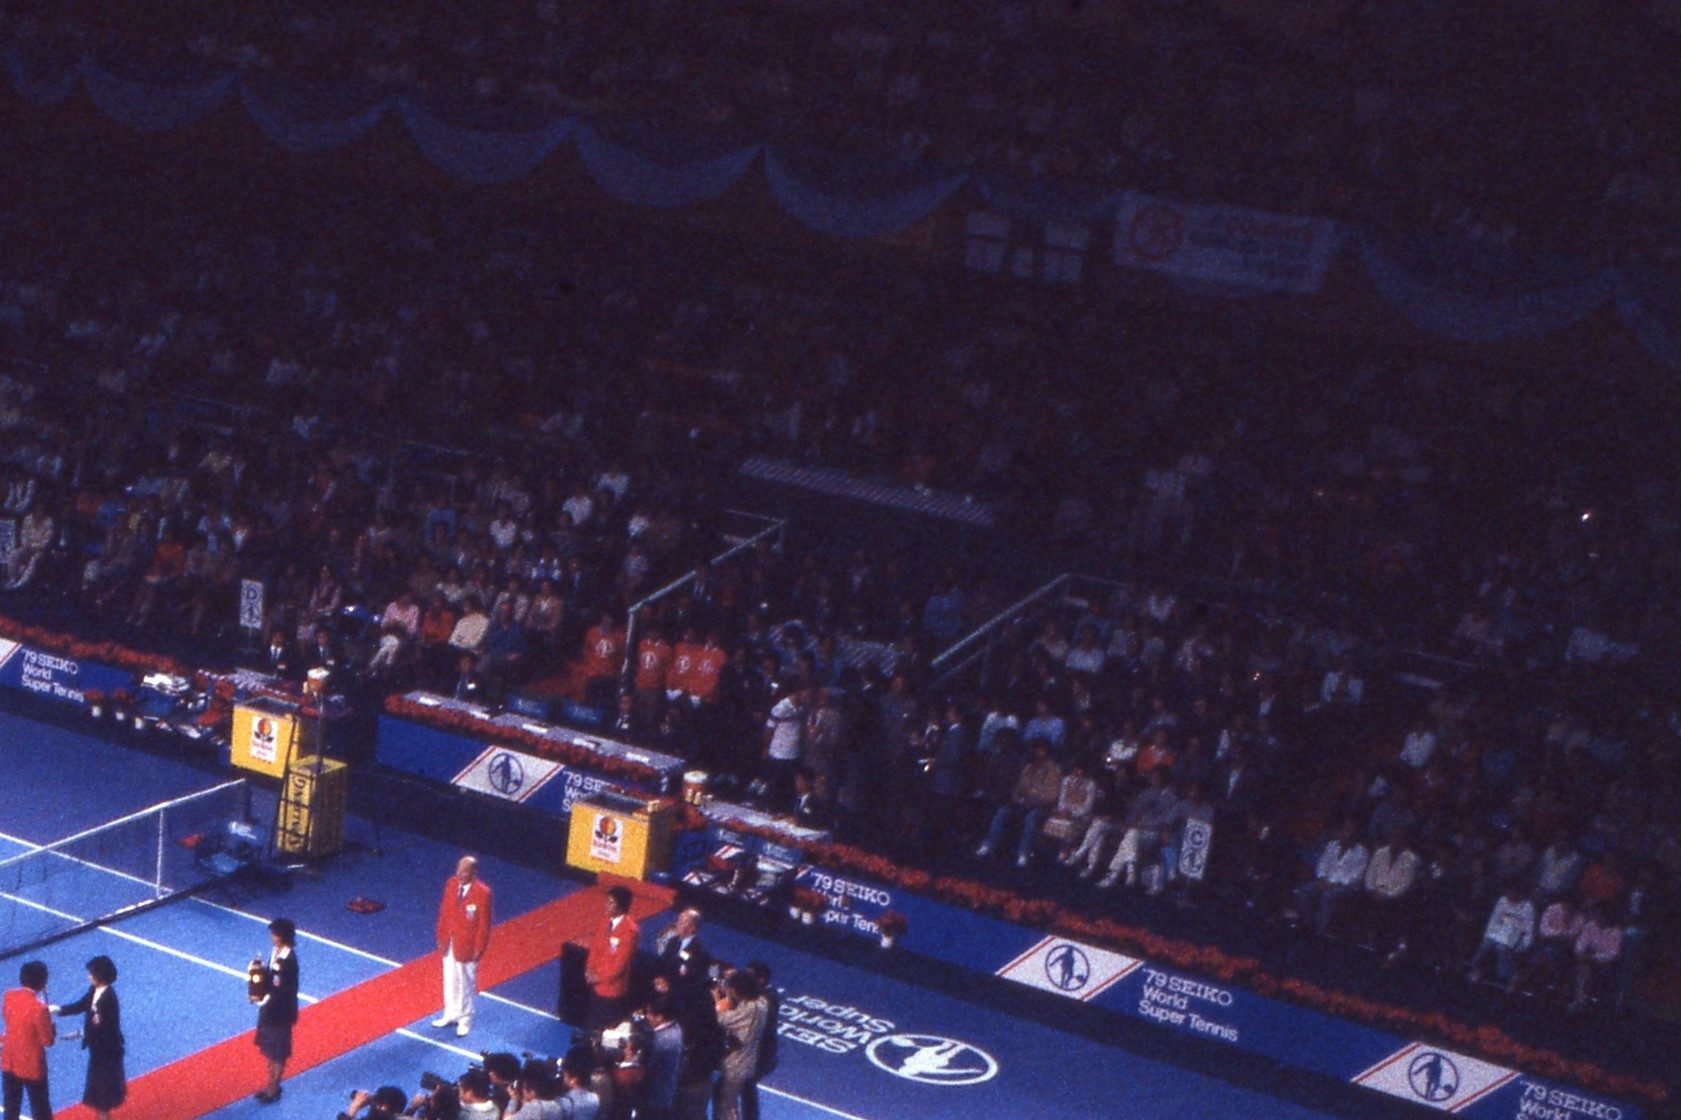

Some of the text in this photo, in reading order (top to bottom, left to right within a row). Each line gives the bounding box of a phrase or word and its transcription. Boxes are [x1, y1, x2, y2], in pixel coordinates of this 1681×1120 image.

[22, 662, 52, 680] World
[37, 653, 78, 675] SEIKO
[21, 674, 85, 703] Super Tennis
[562, 770, 583, 788] '79
[809, 871, 833, 890] '79
[833, 877, 891, 907] SEIKO
[1142, 967, 1233, 1007] '79 SEIKO
[1142, 984, 1188, 1010] World
[785, 995, 896, 1034] Super
[1138, 999, 1238, 1042] Super Tennis
[776, 1020, 858, 1054] SEI
[1519, 1080, 1548, 1101] '79
